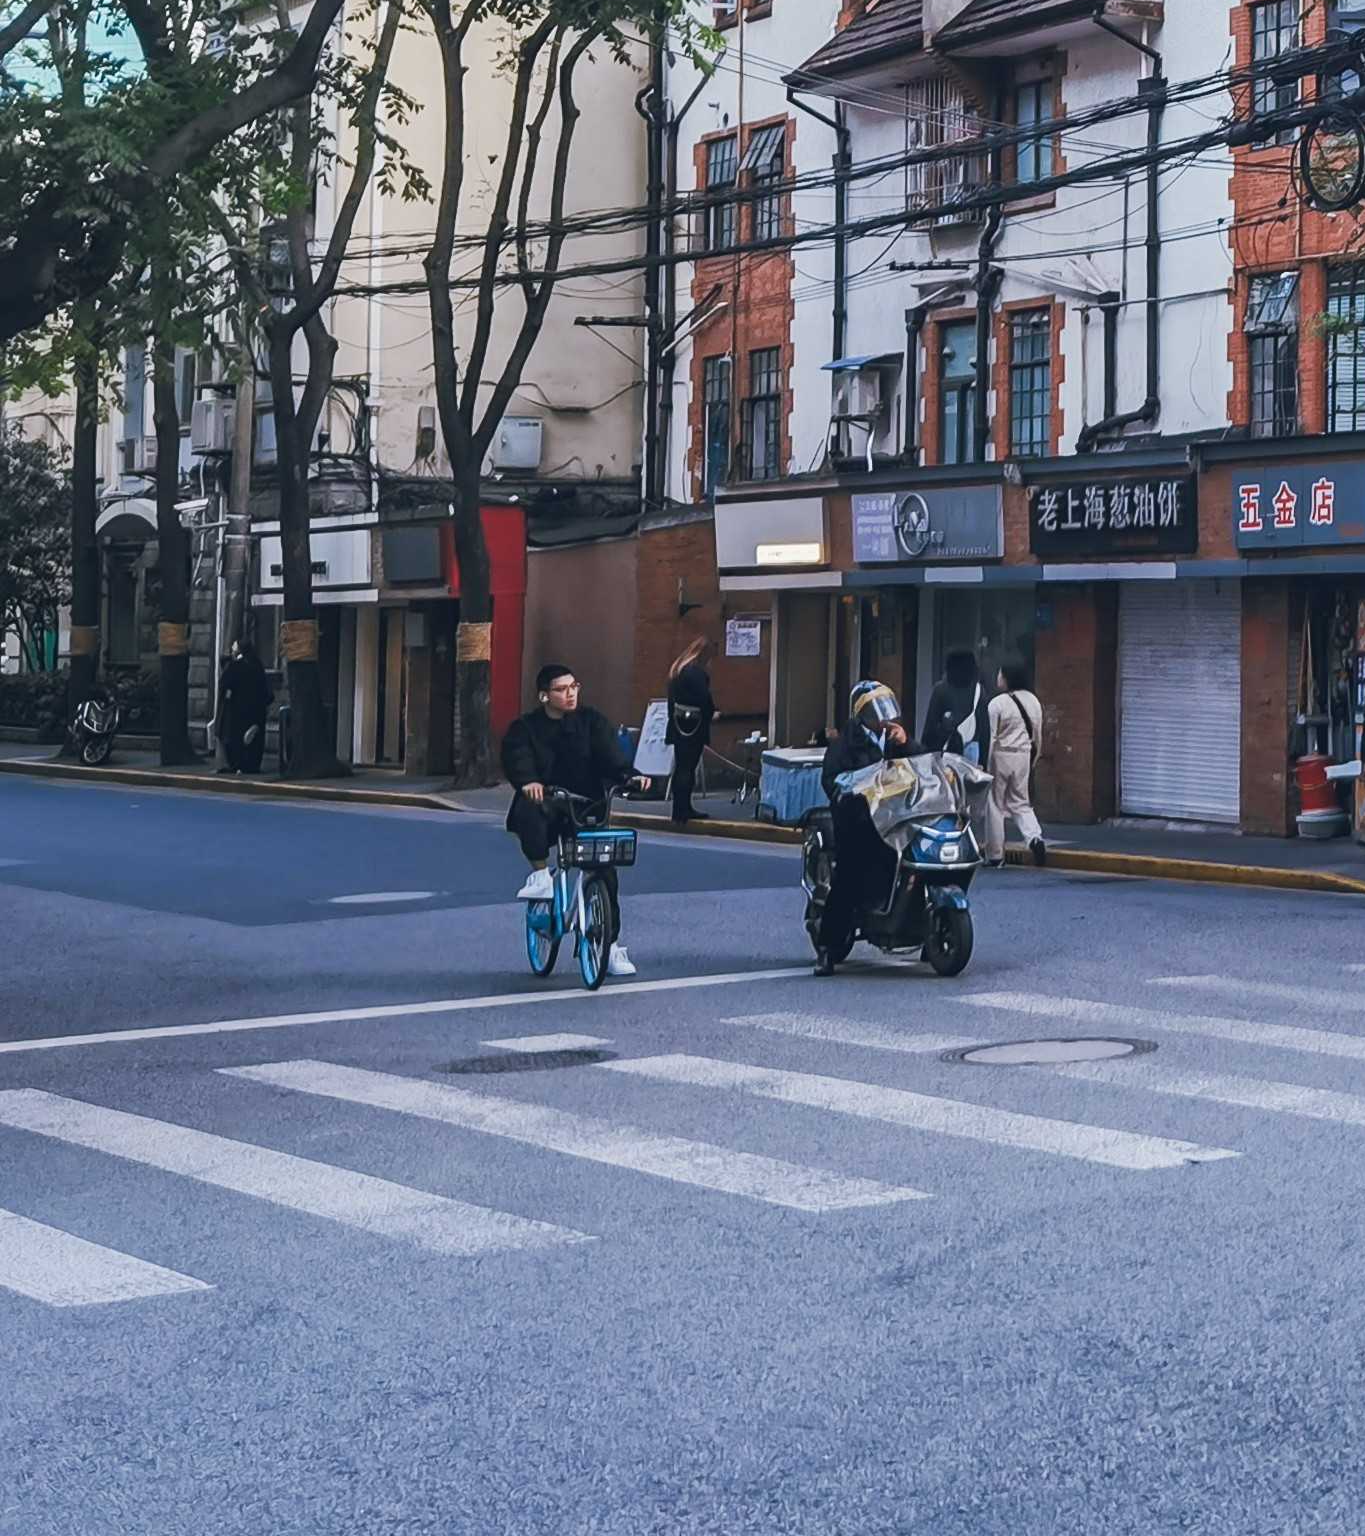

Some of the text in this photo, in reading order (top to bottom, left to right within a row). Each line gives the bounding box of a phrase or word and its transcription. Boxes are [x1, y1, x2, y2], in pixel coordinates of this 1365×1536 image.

[1038, 481, 1182, 531] 老上海葱油饼
[1239, 477, 1334, 531] 五金店
